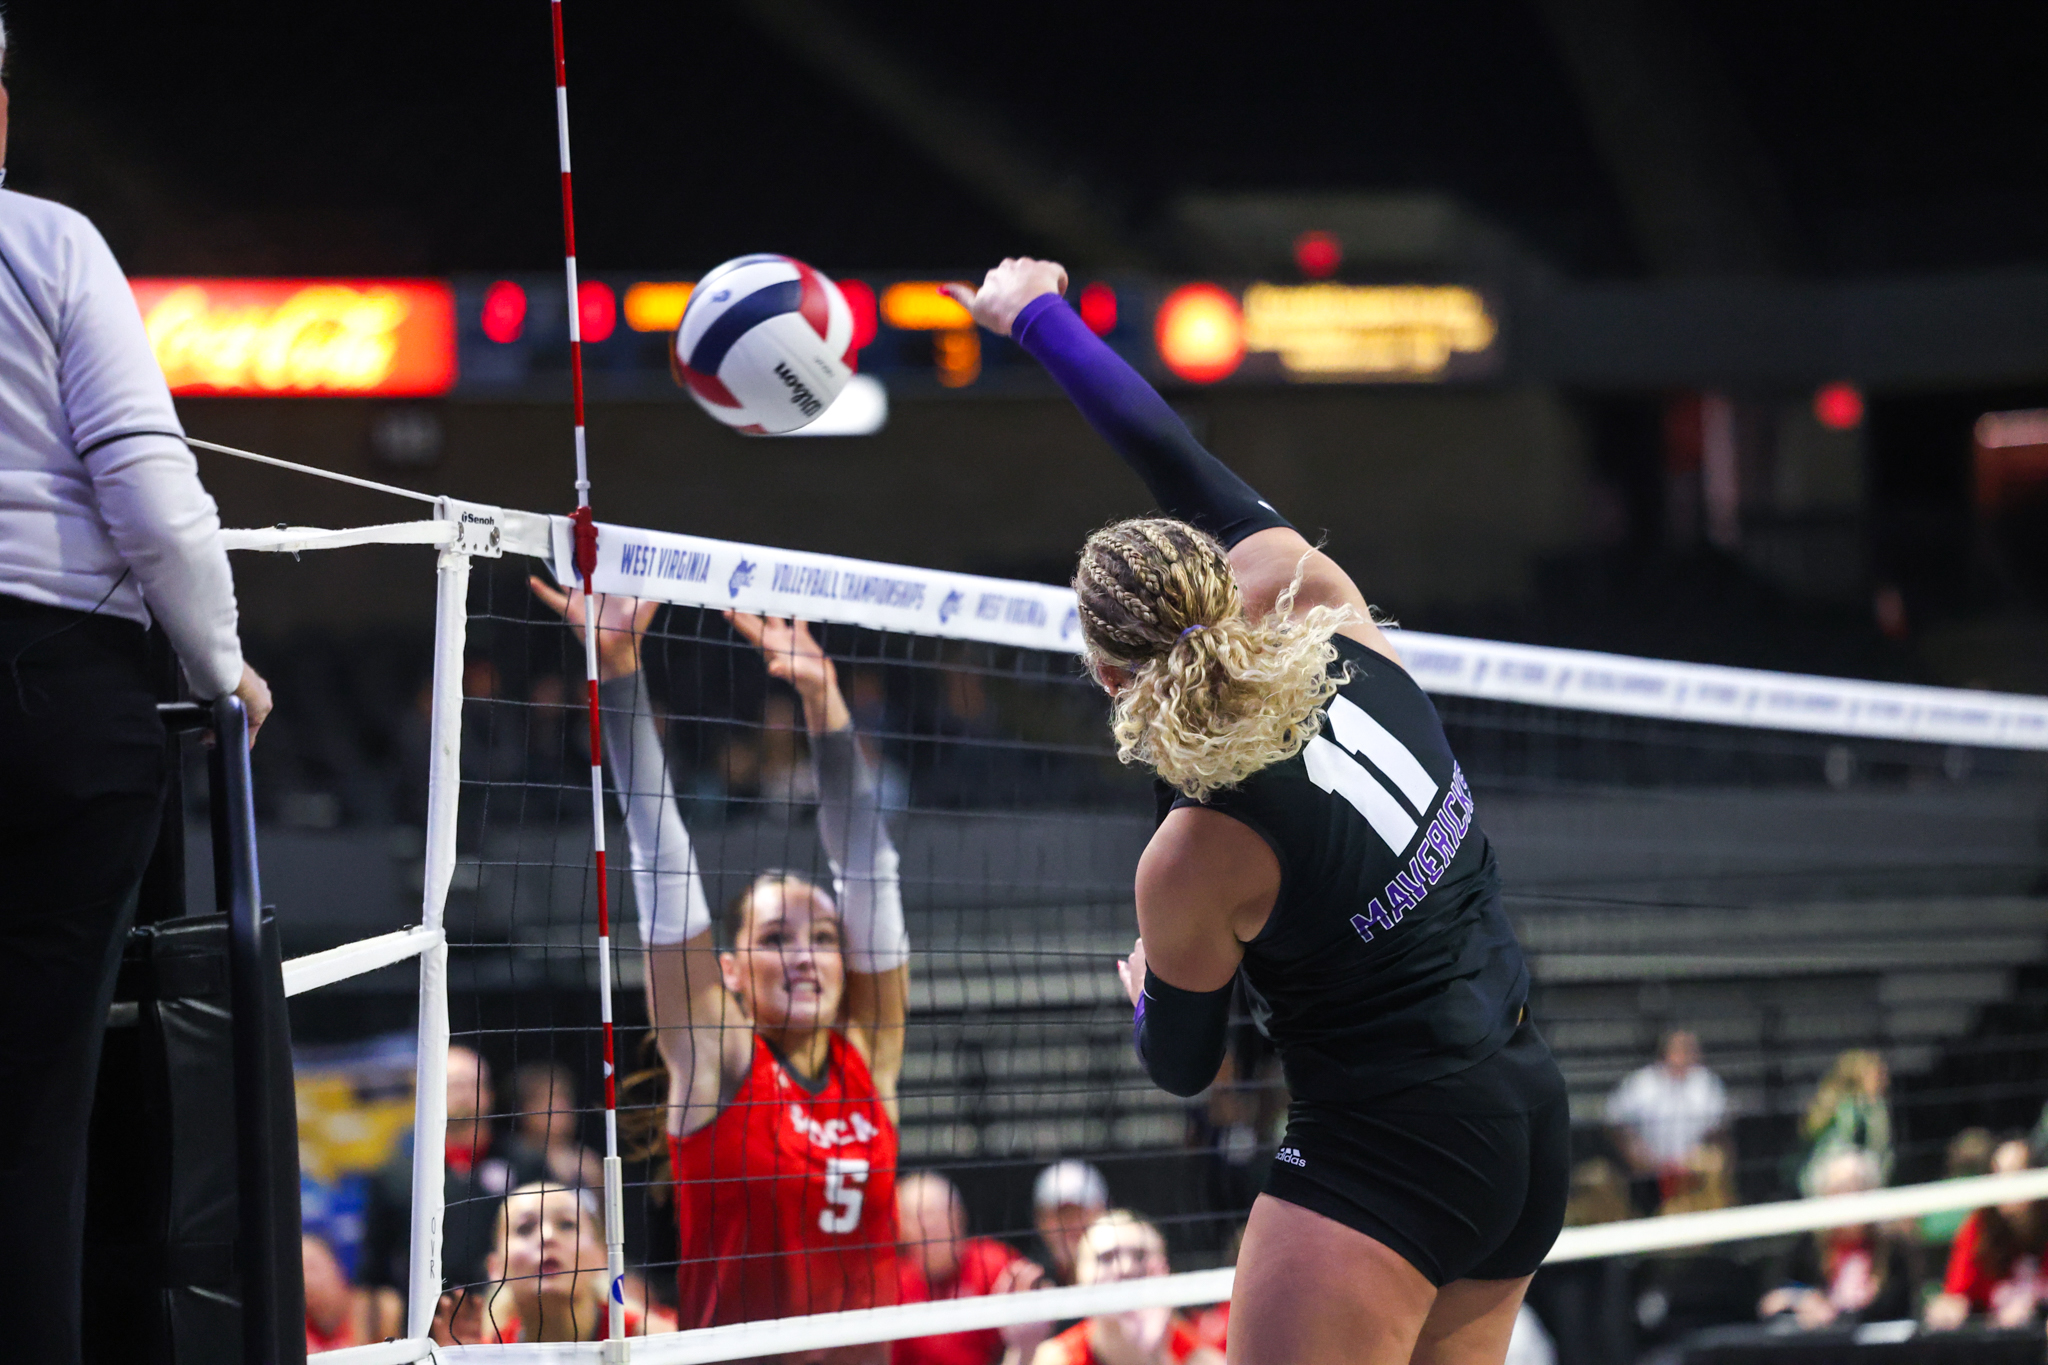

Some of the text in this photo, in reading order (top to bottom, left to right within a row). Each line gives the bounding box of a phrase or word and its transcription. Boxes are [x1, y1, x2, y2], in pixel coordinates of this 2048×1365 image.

[774, 362, 821, 417] Wilson
[467, 513, 495, 525] Senoh
[620, 543, 711, 583] WEST VIRGINIA
[1303, 693, 1439, 857] 11
[818, 1157, 870, 1233] 5
